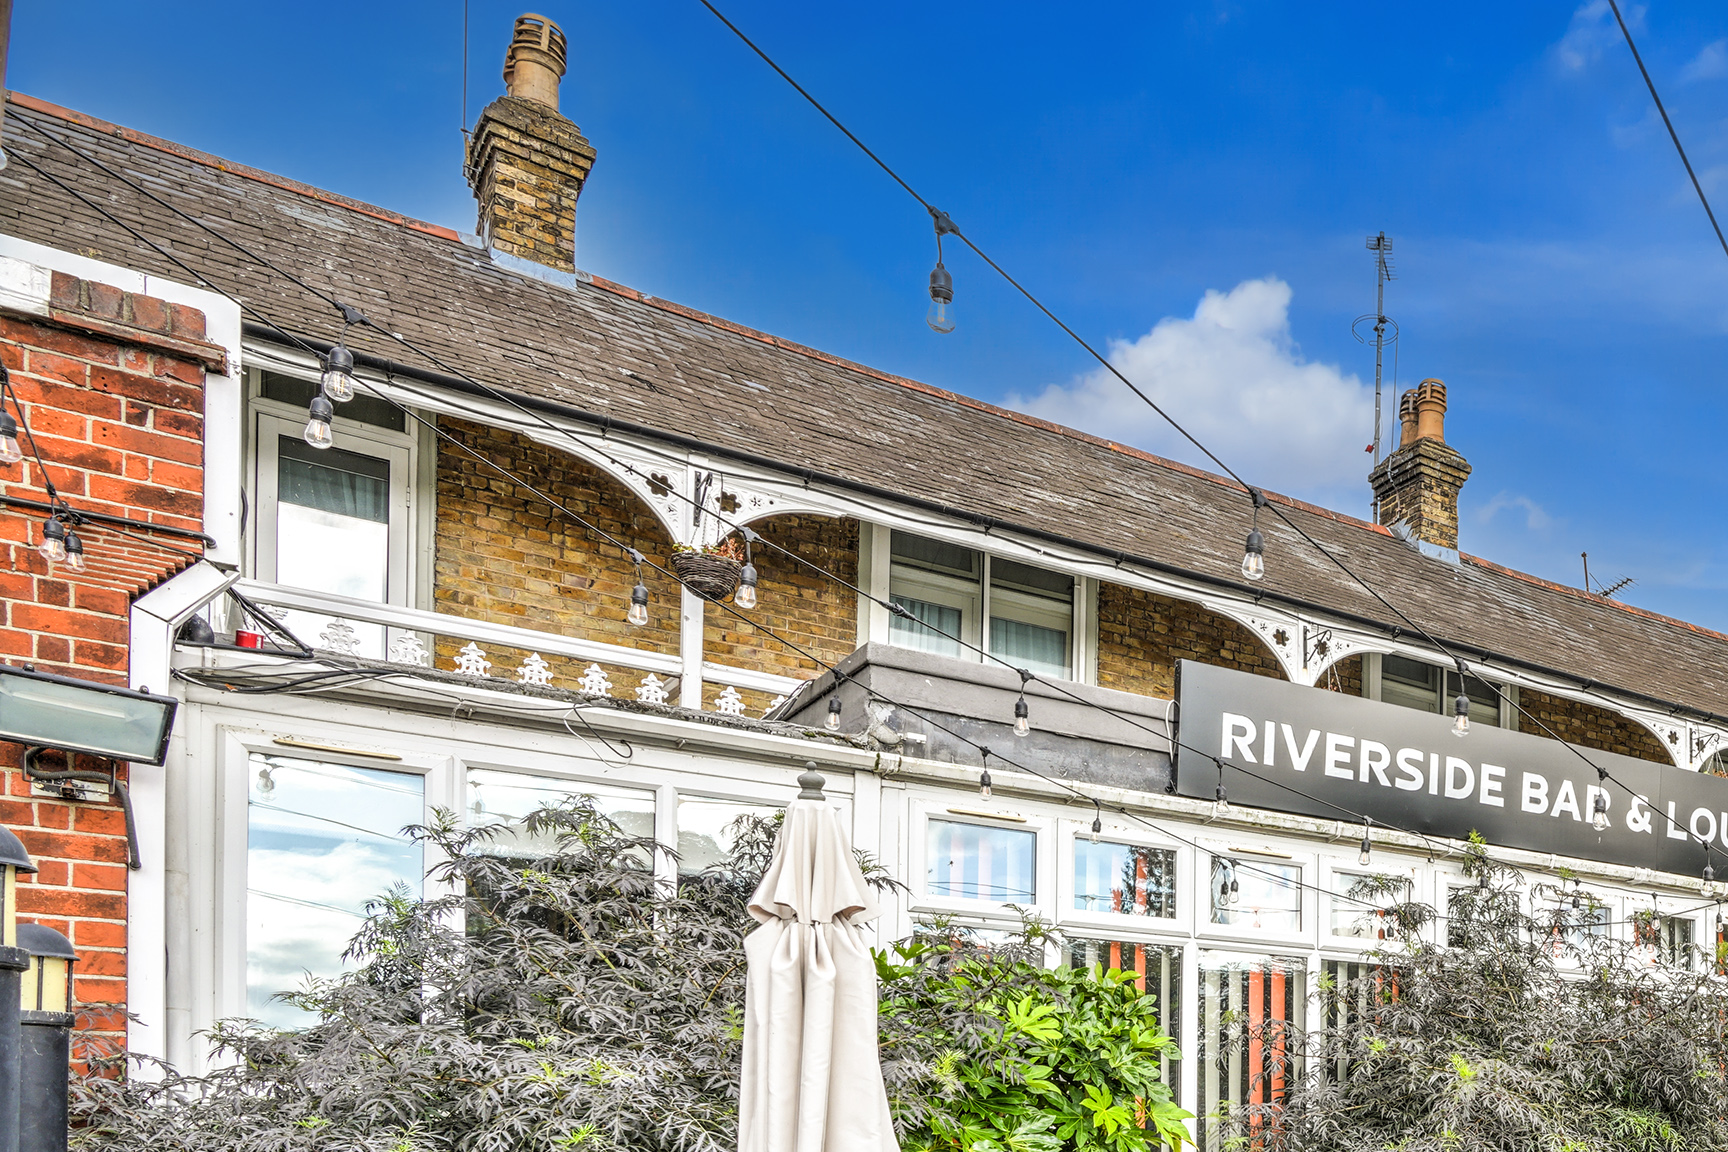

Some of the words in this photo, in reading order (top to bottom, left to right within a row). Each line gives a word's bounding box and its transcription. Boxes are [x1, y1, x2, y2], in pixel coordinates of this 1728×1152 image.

[1221, 712, 1506, 807] RIVERSIDE
[1521, 771, 1611, 827] BAR
[1626, 794, 1652, 834] &
